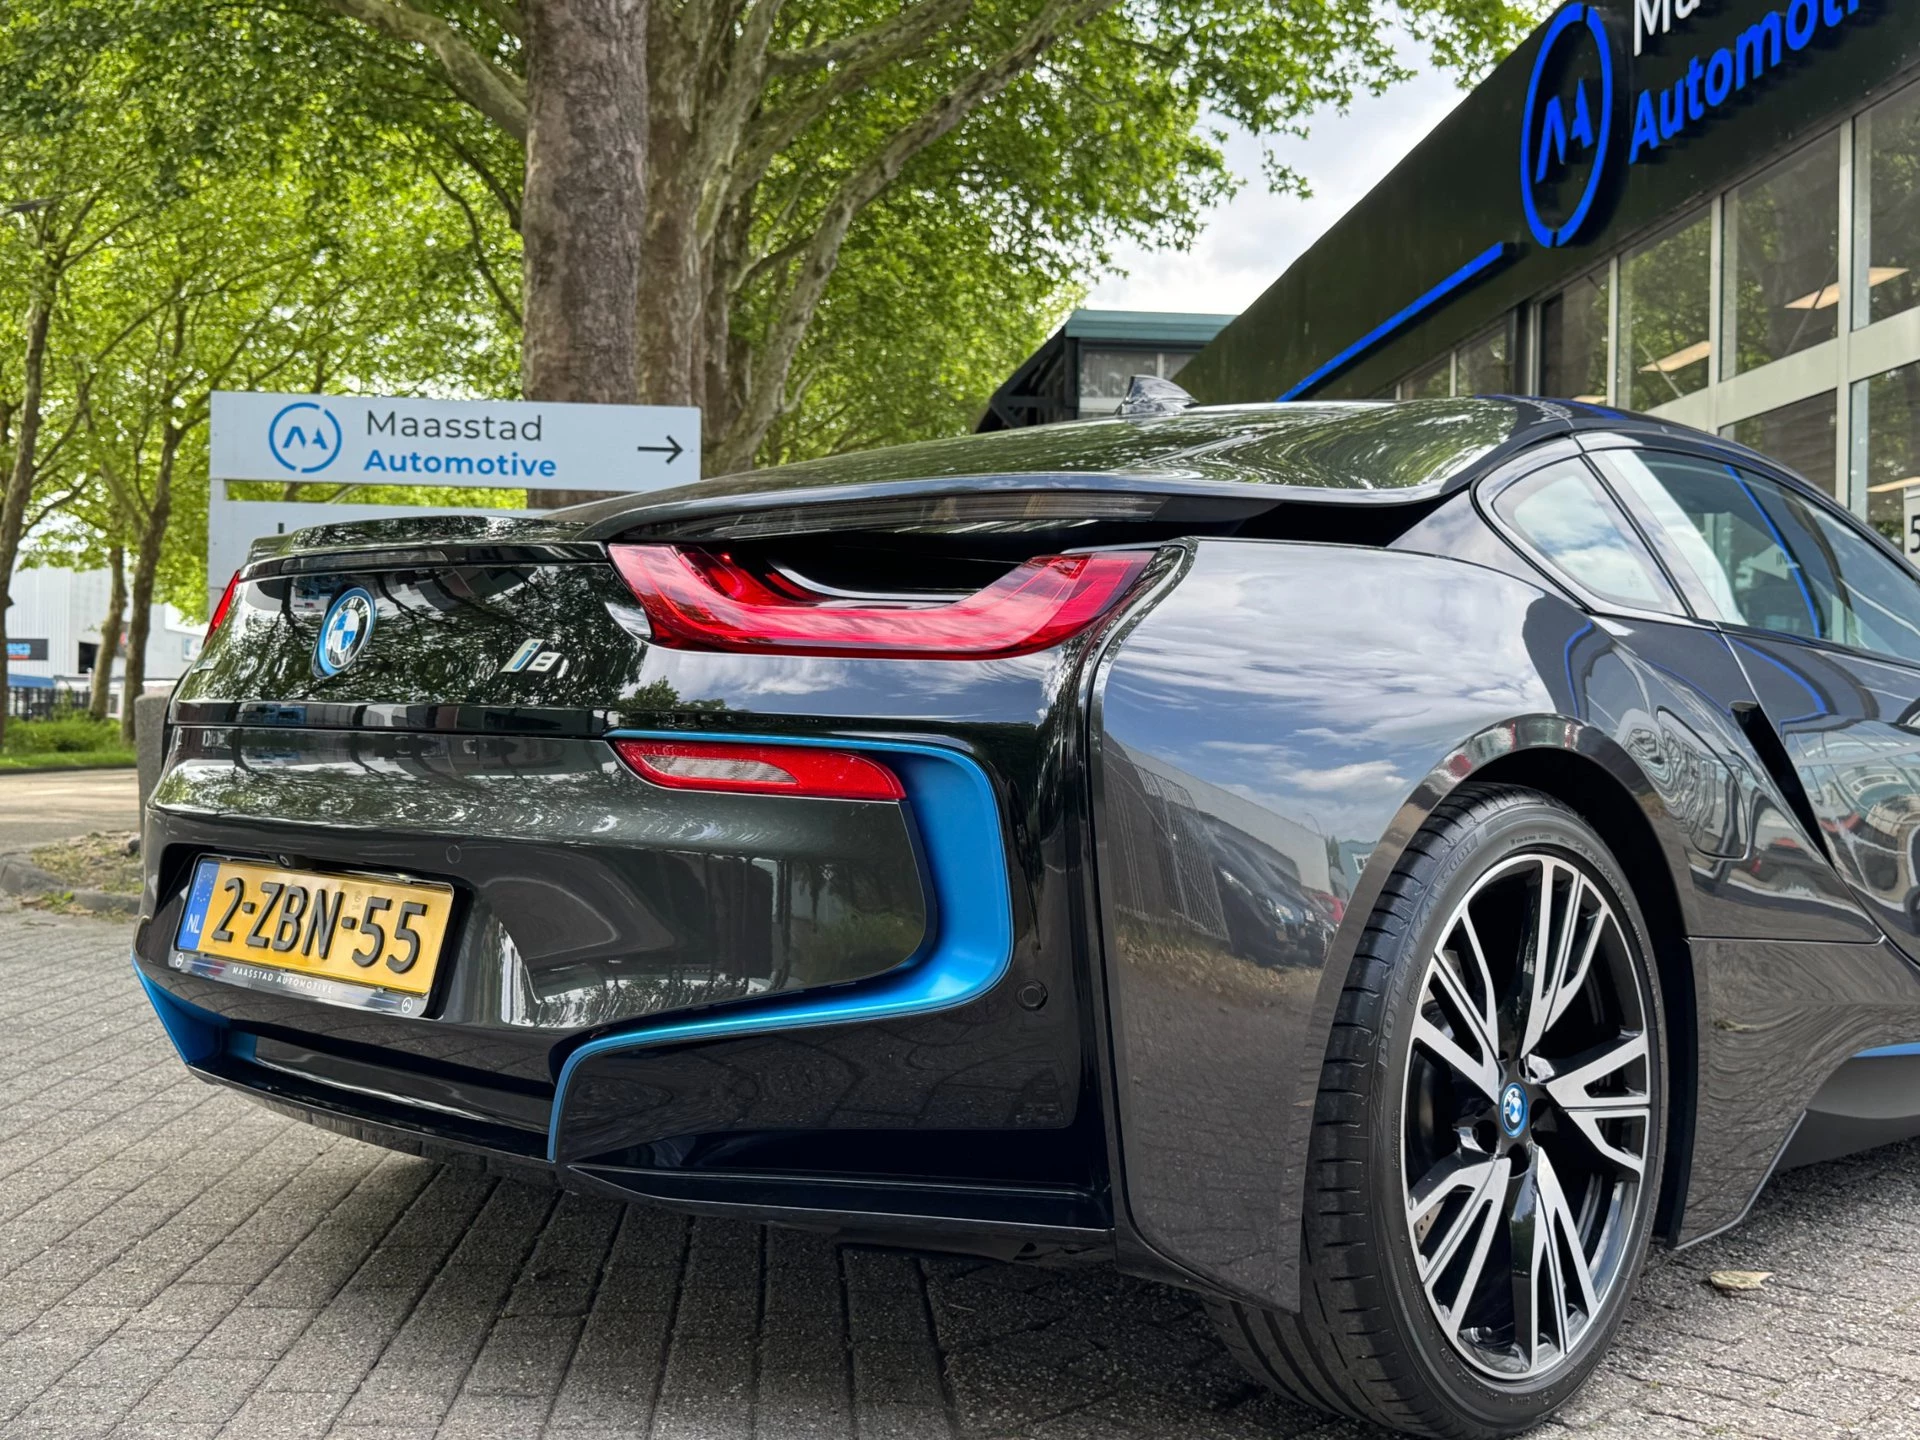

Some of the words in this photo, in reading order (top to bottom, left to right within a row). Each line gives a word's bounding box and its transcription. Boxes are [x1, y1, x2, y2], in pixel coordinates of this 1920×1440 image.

[367, 410, 543, 442] Maasstad
[363, 449, 557, 478] Automotive
[185, 914, 201, 934] NL
[211, 877, 428, 975] 2-ZBN-55
[232, 966, 274, 983] MAASSTAD
[276, 974, 334, 995] AUTOMOTIVE
